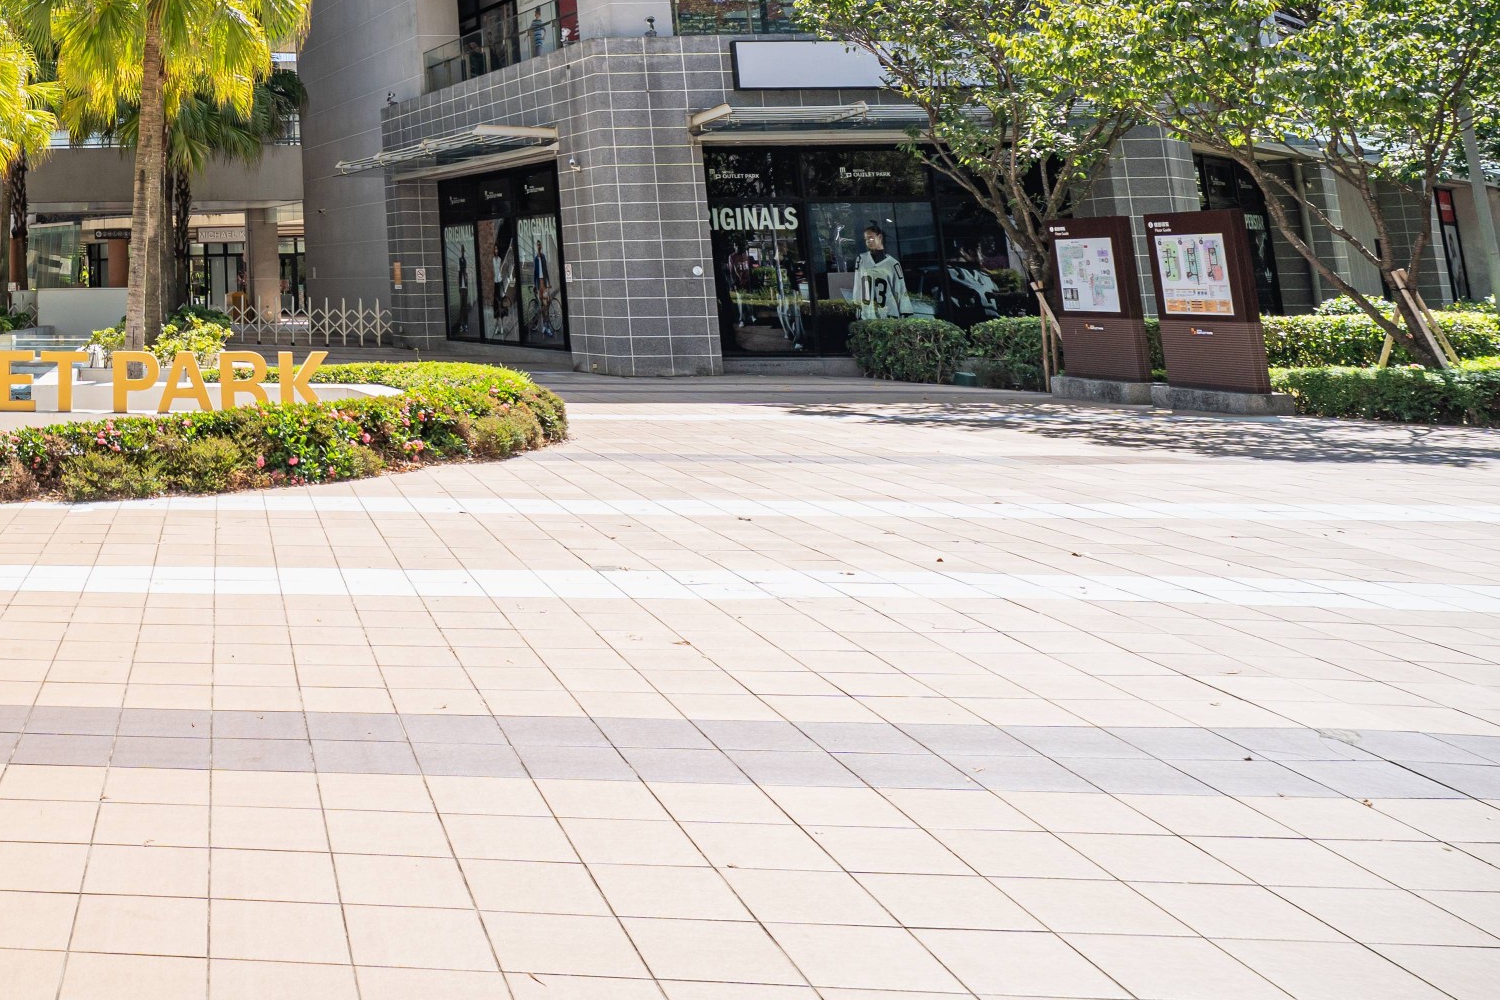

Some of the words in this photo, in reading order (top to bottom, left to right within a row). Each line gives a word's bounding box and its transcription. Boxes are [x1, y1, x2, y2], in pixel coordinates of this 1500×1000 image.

[709, 207, 799, 231] IGINALS
[199, 231, 236, 239] MICHAEL
[112, 350, 330, 414] PARK
